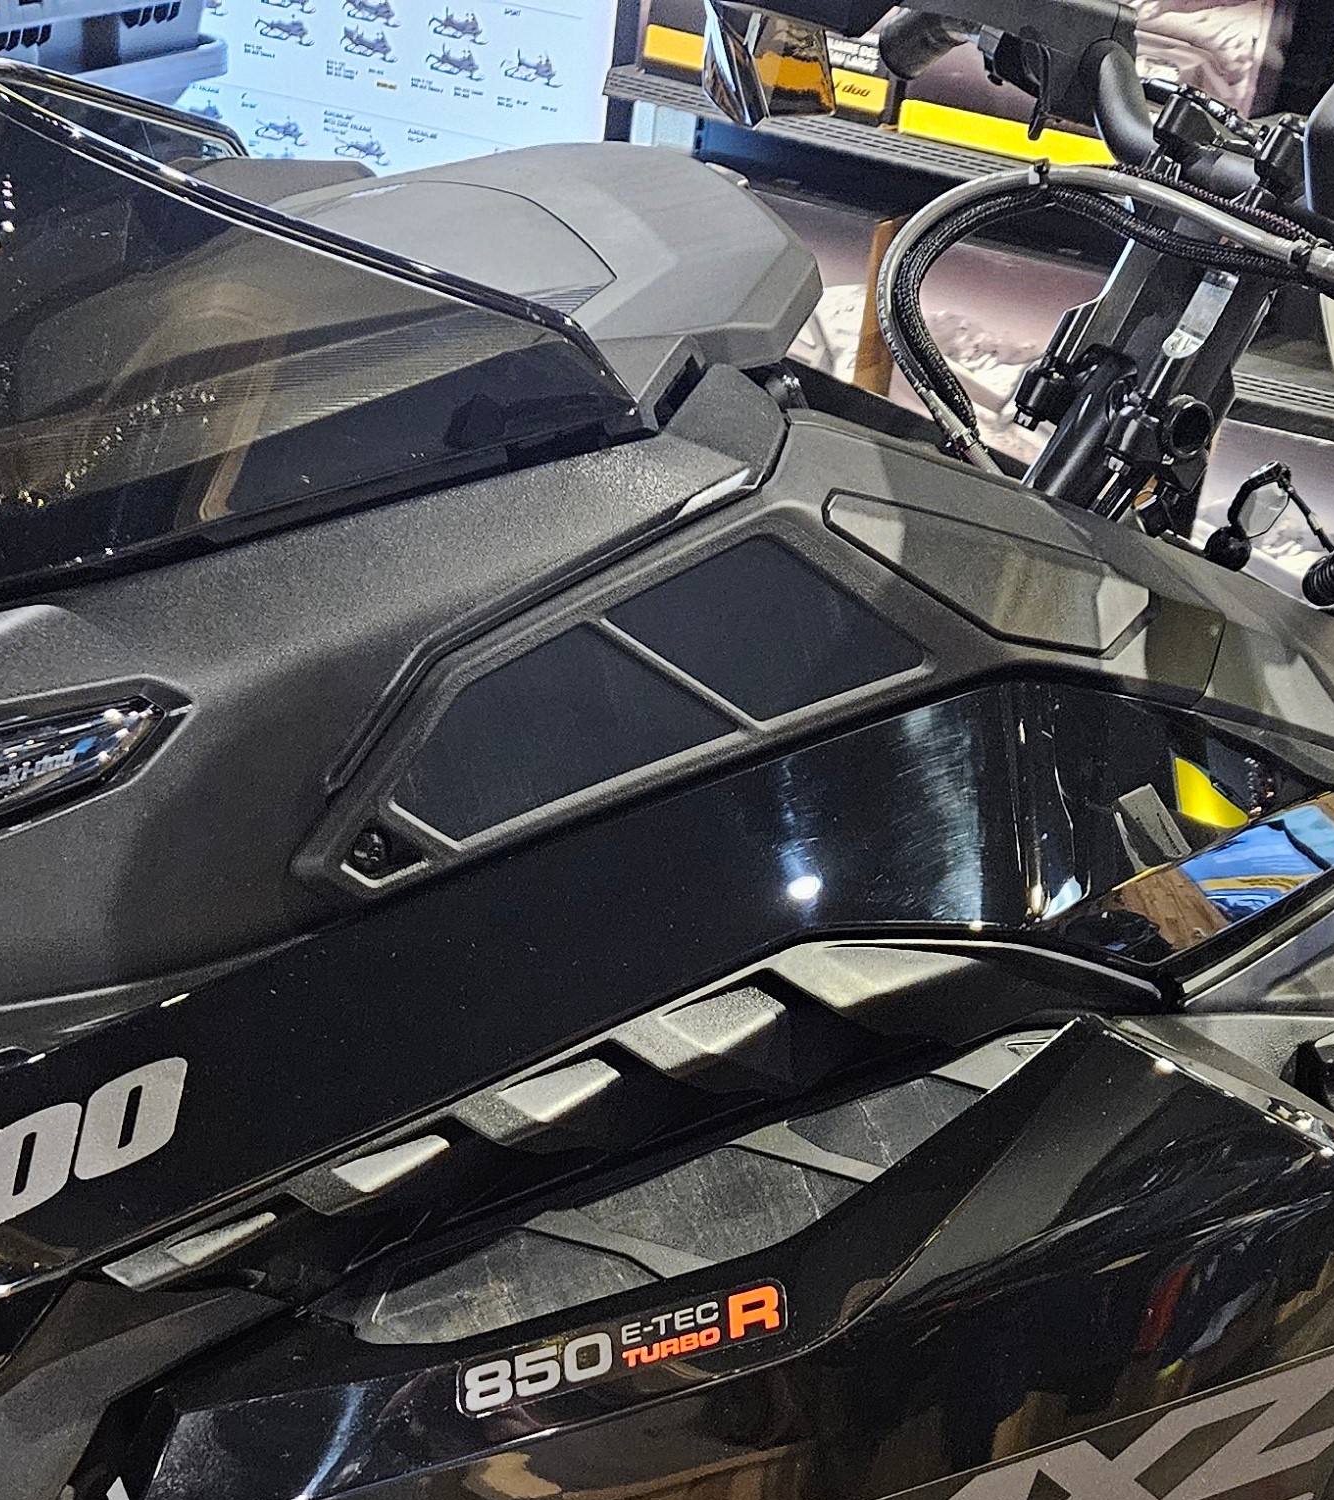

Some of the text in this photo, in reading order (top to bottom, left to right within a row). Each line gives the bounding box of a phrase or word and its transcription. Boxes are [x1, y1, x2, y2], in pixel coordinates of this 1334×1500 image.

[621, 1302, 719, 1346] E-TEC
[728, 1285, 780, 1340] R
[464, 1332, 613, 1413] 850
[621, 1327, 721, 1369] TURBO
